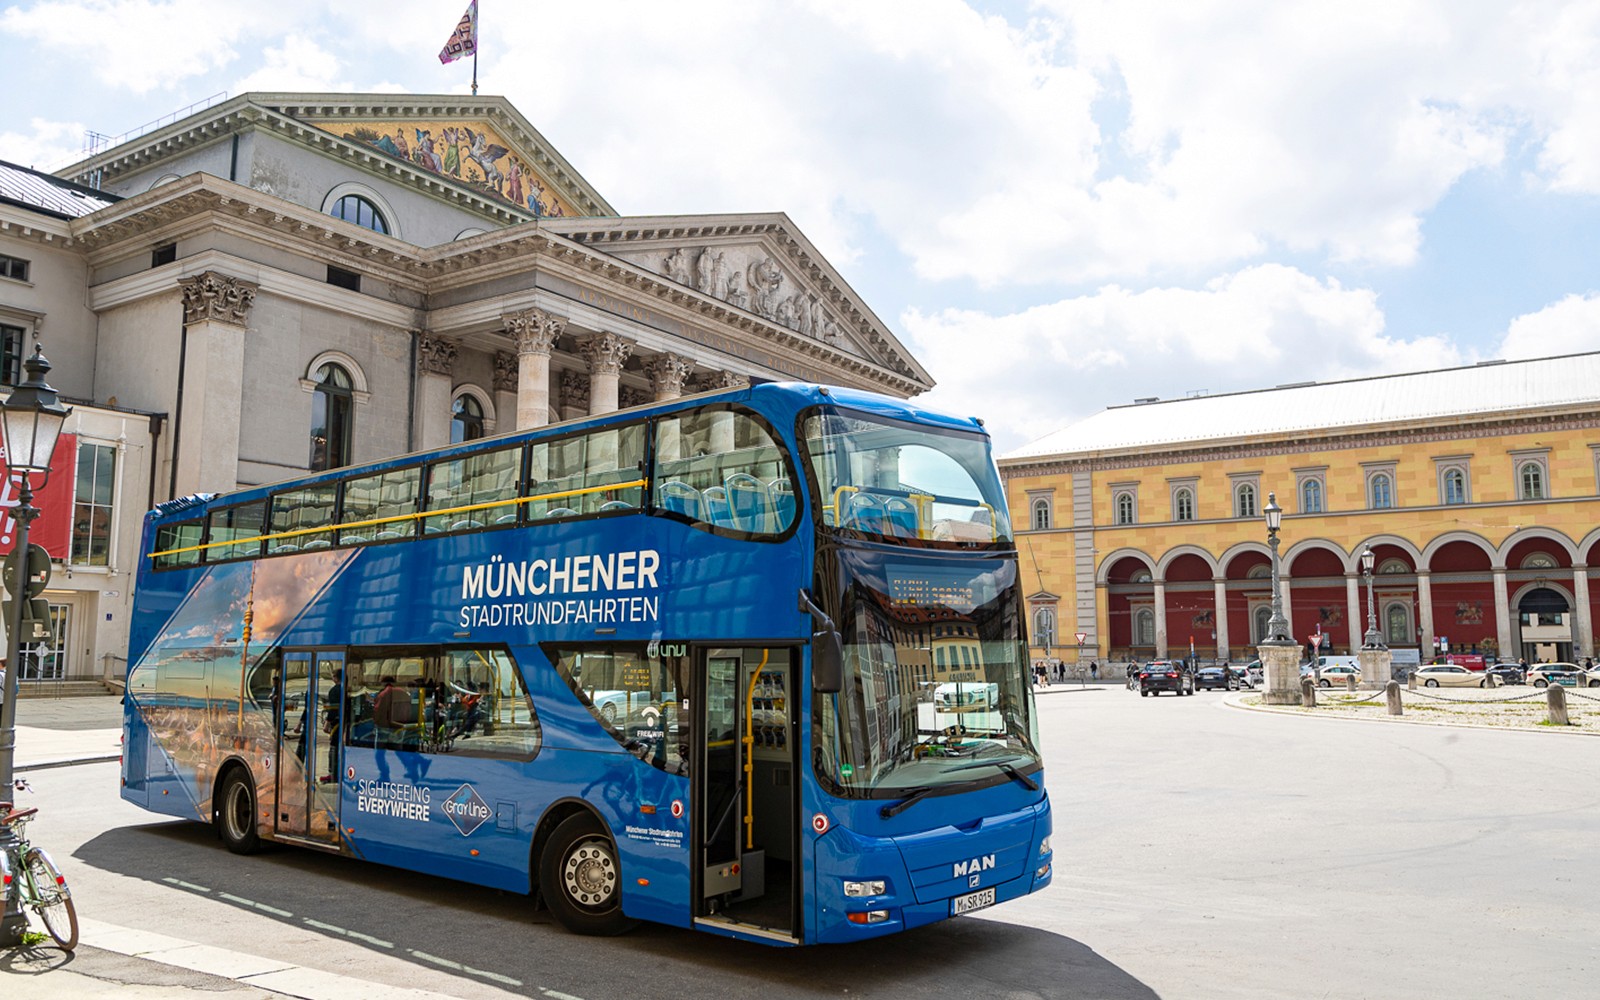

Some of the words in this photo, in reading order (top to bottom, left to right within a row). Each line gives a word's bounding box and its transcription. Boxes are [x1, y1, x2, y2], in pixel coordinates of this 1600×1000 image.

[461, 549, 660, 600] MÜNCHENER
[460, 596, 659, 628] STADTRUNDFAHRTEN
[358, 778, 431, 804] SIGHTSEEING
[358, 796, 430, 822] EVERYWHERE
[954, 854, 995, 878] MAN
[967, 894, 978, 909] SR
[979, 891, 992, 905] 915
